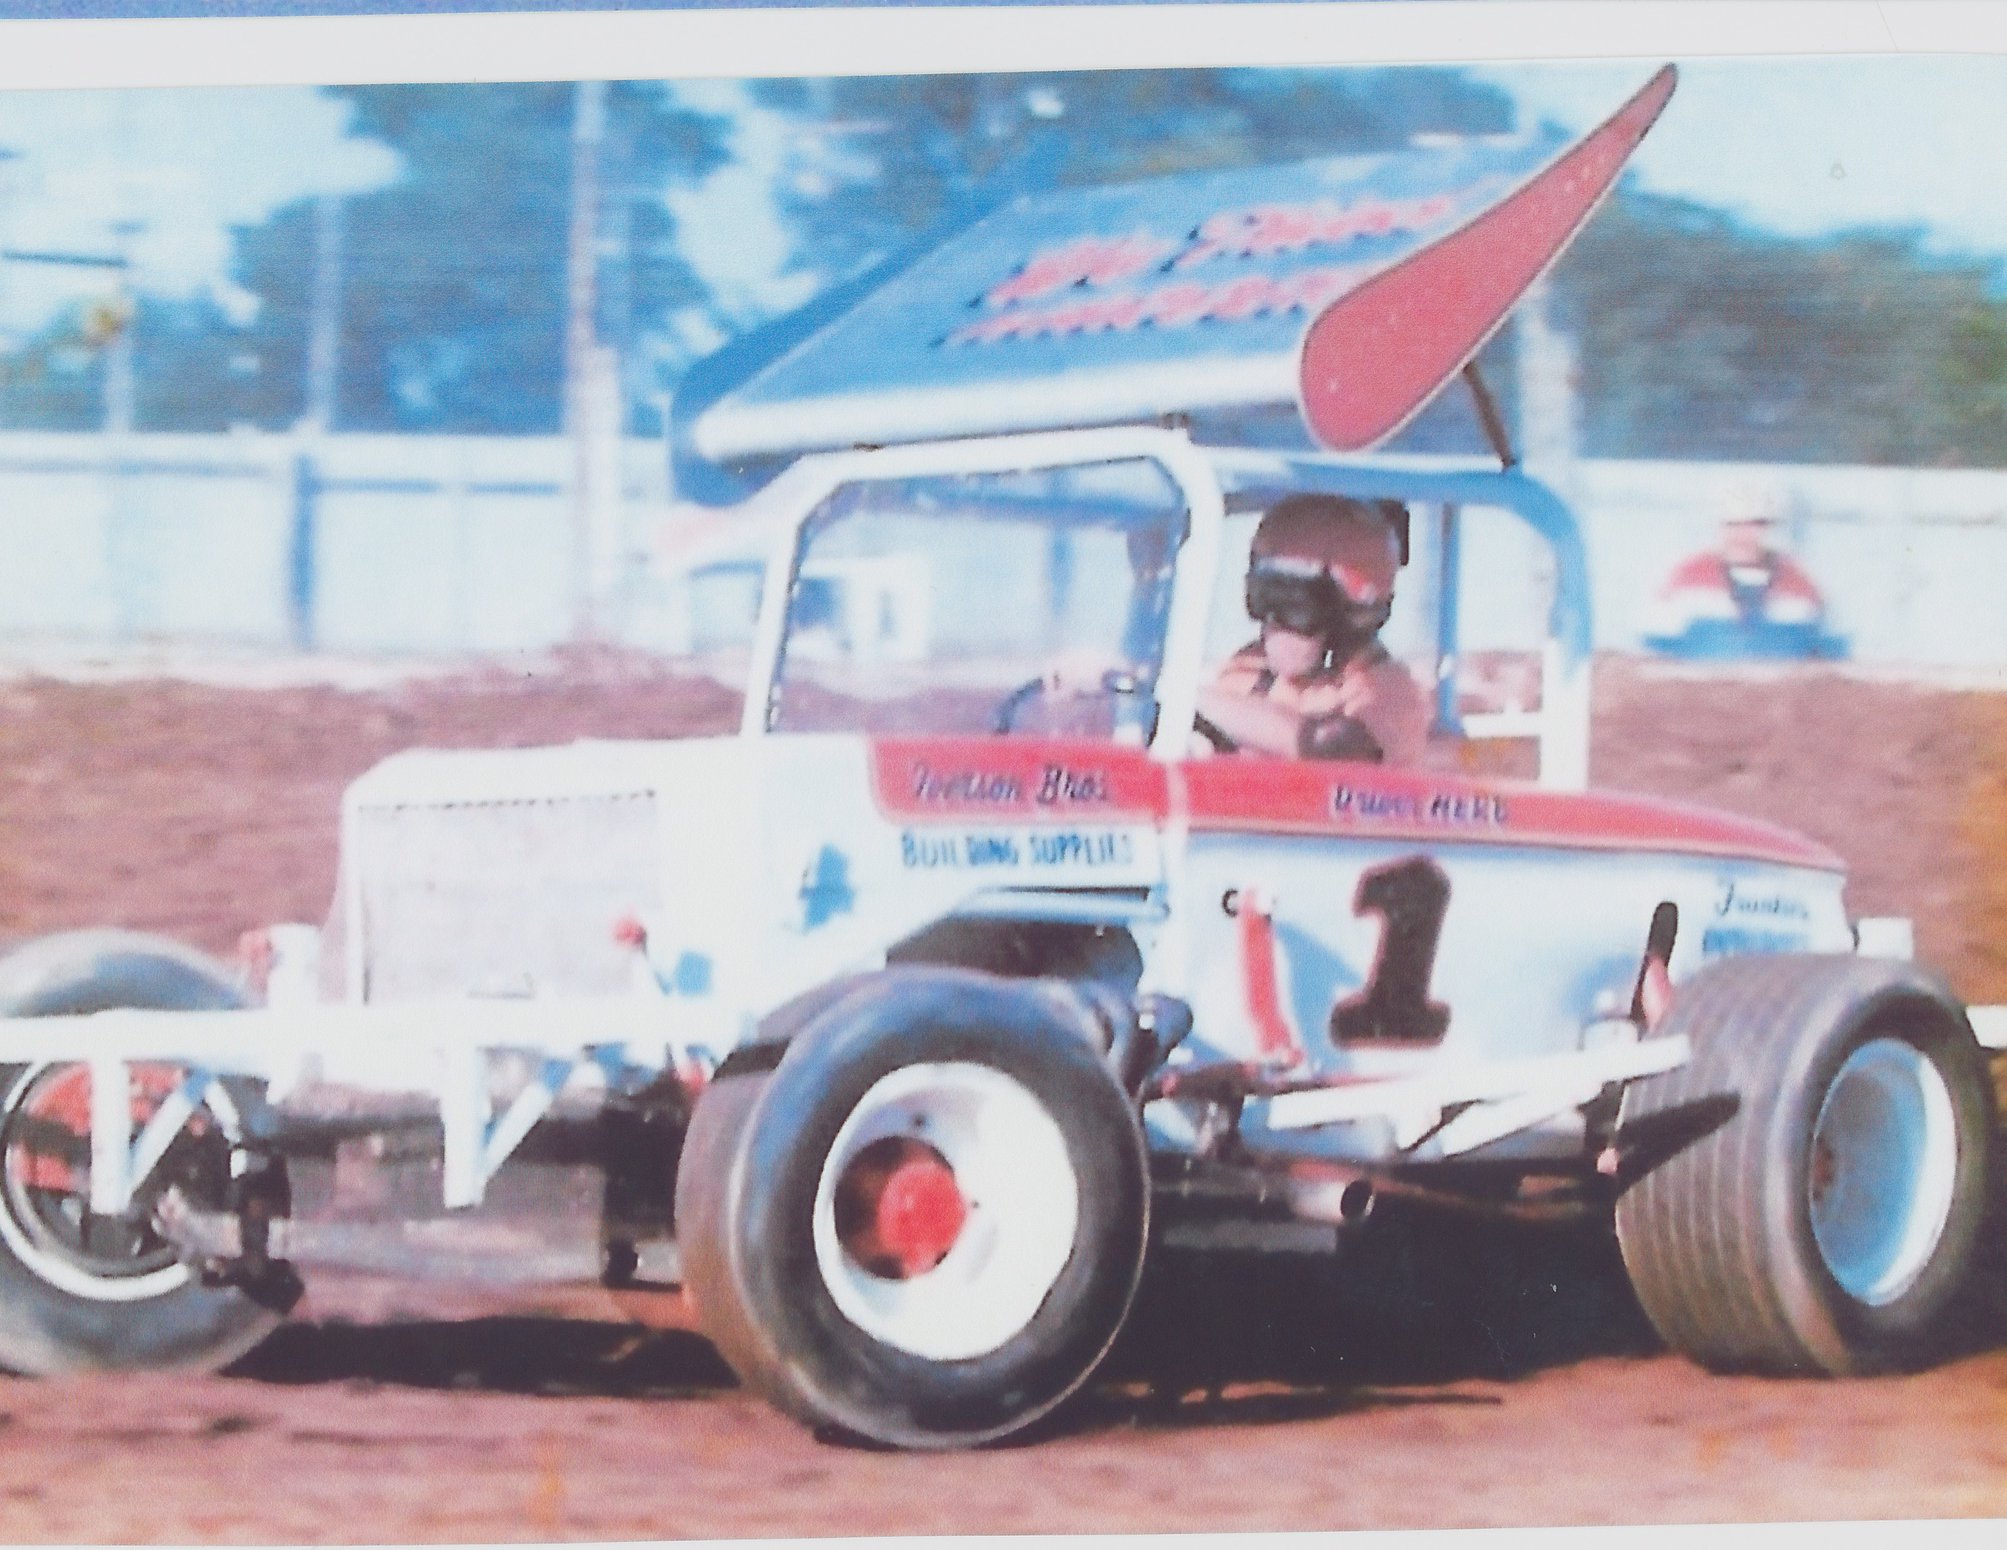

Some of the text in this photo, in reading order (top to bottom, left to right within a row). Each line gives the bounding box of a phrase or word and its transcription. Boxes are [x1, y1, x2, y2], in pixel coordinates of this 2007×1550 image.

[901, 829, 1133, 867] BUILDING SUPPLIES
[1330, 855, 1452, 1049] 1
